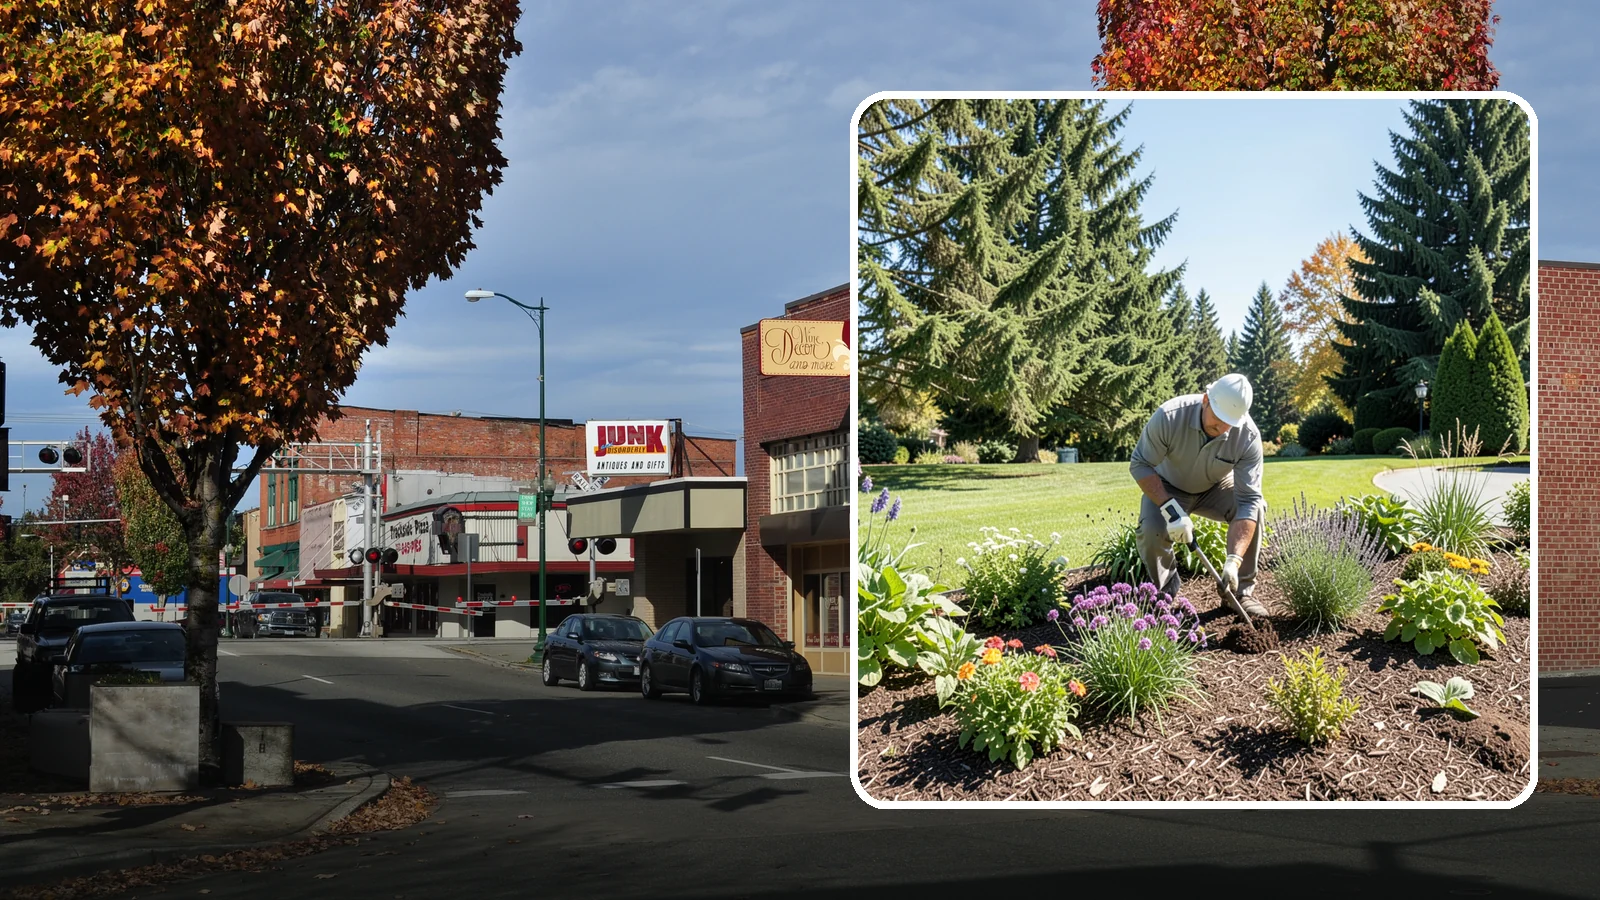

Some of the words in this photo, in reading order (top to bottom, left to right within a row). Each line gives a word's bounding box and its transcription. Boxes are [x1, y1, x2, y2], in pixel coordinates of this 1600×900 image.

[765, 328, 831, 365] Decor
[595, 425, 665, 457] JUNK
[607, 446, 646, 454] DISORDERLY
[596, 461, 628, 470] ANTIQUES
[631, 461, 644, 469] AND
[647, 460, 665, 469] GIFTS
[414, 519, 429, 535] Pizza
